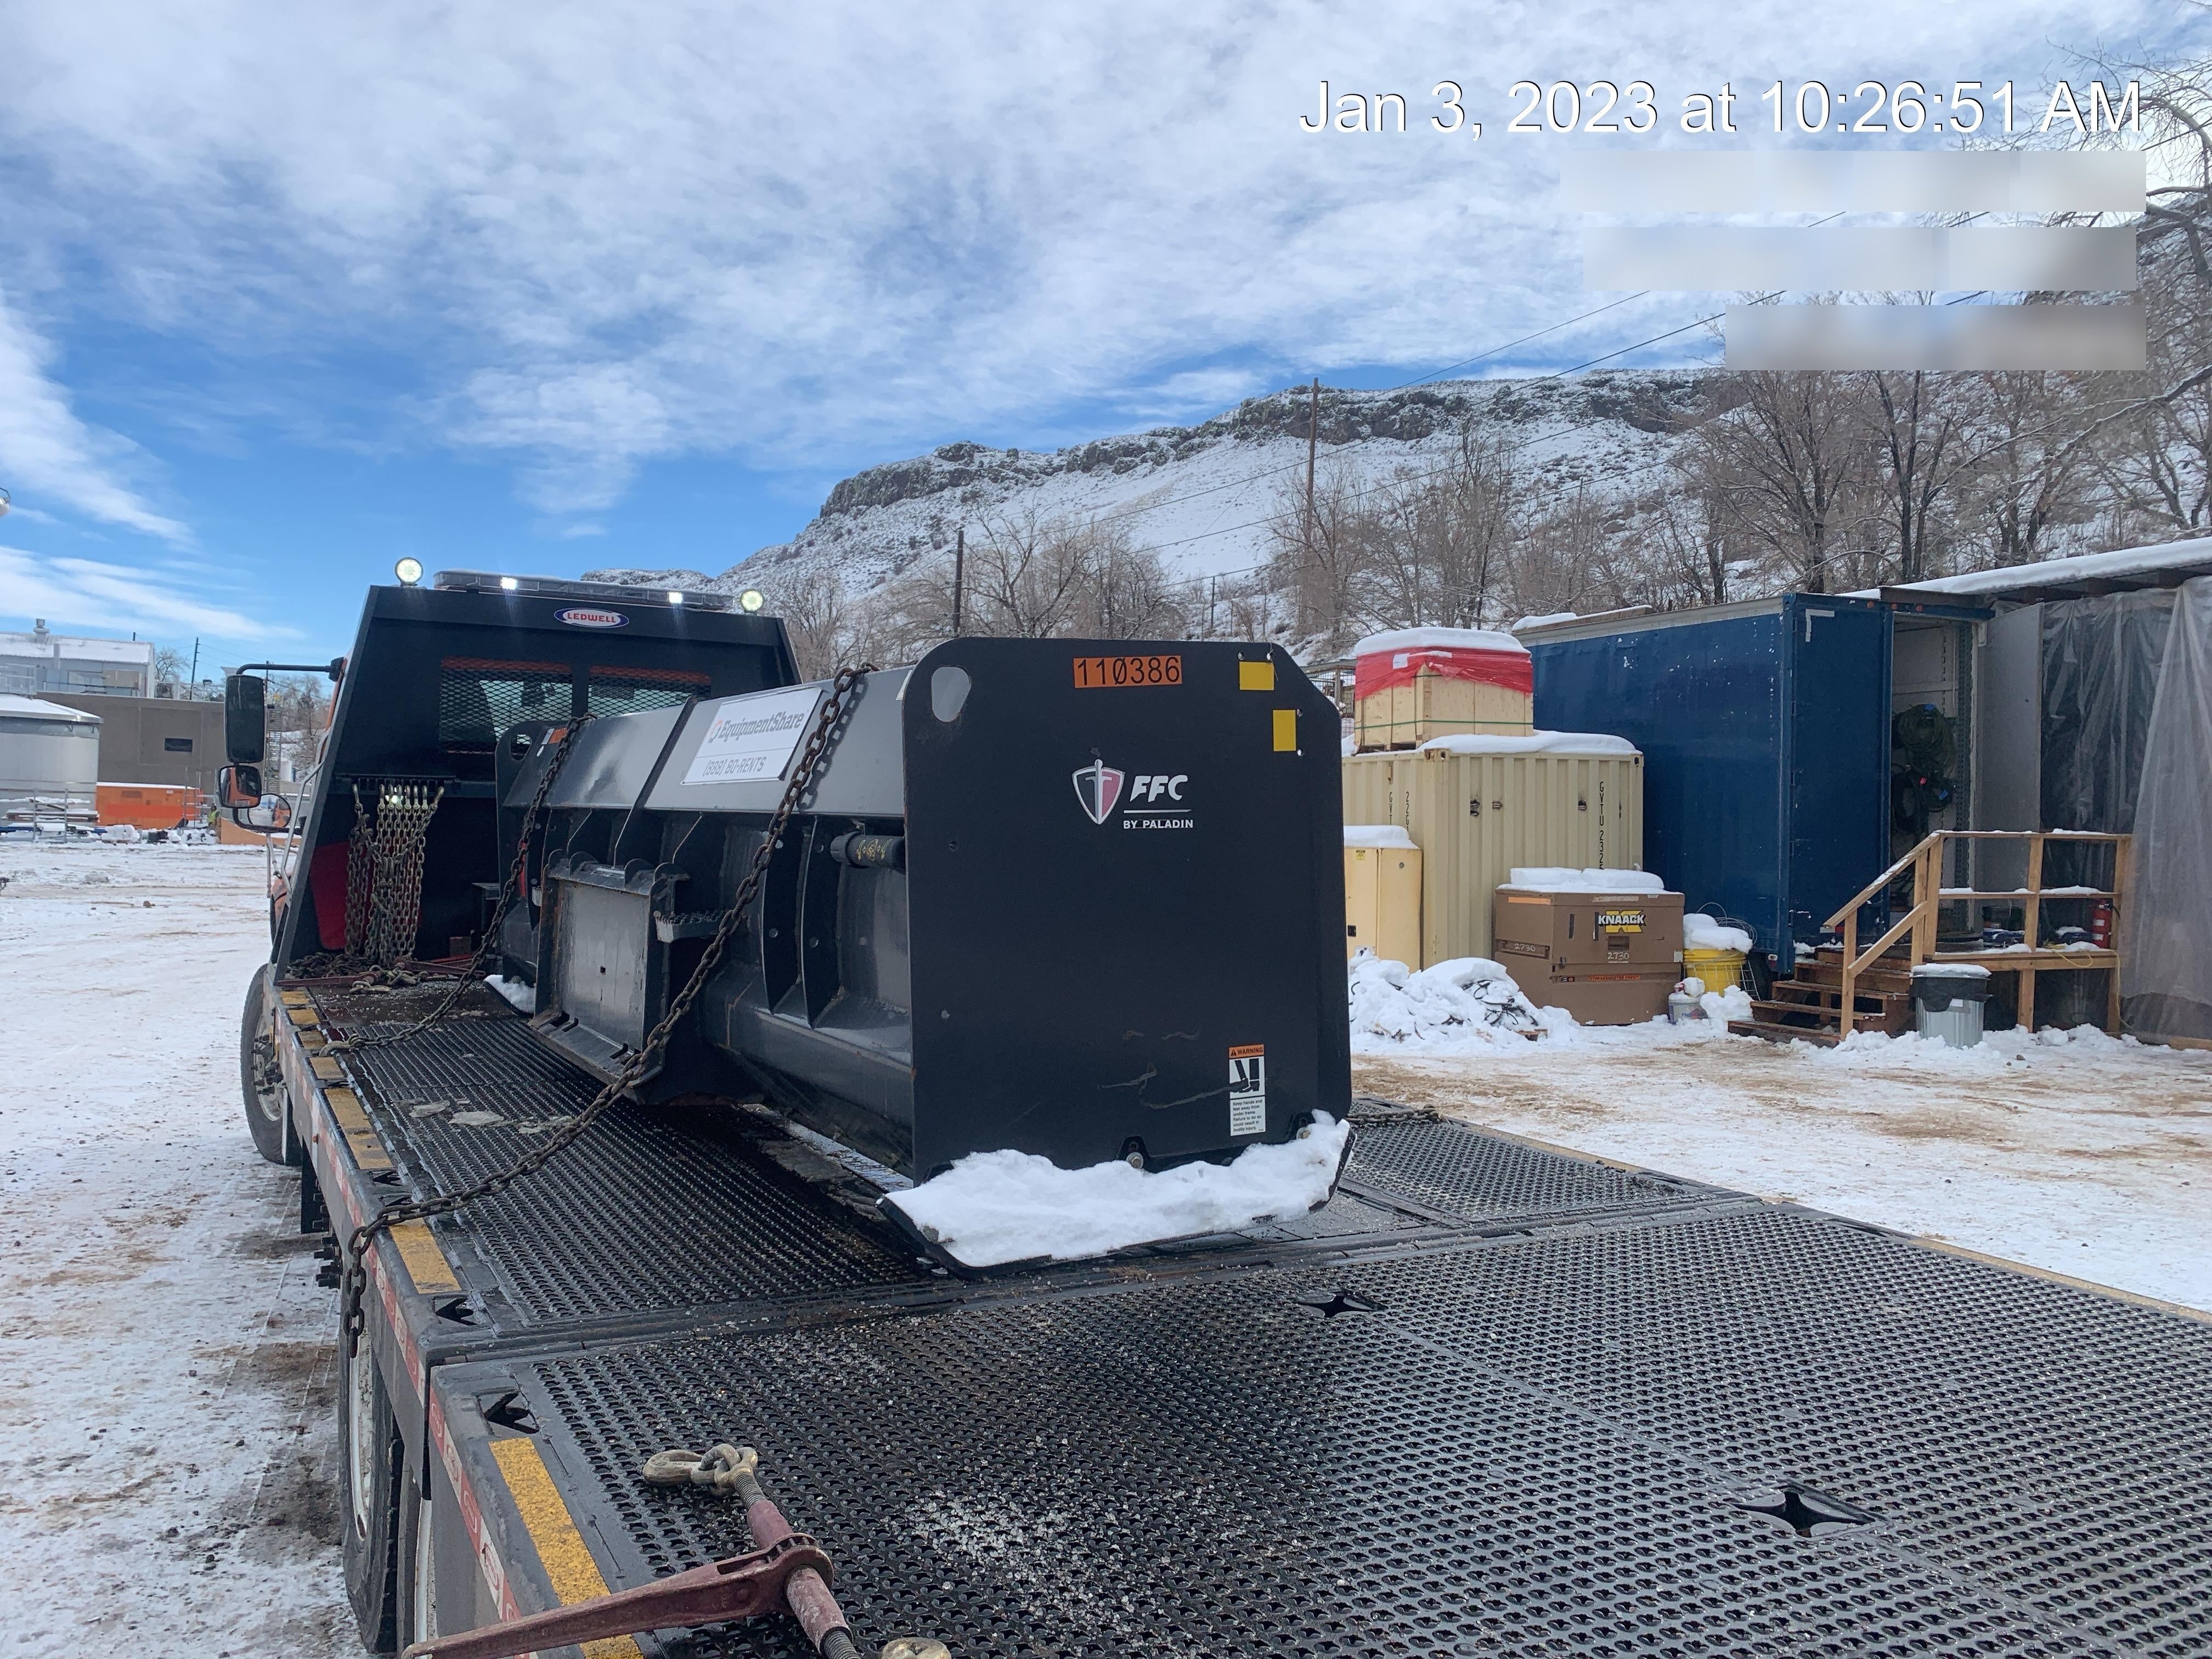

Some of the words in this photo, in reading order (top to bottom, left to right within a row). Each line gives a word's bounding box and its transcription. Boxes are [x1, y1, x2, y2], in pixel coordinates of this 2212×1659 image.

[567, 612, 616, 623] LEDWELL
[1077, 656, 1180, 685] 110386
[718, 712, 805, 742] EquipmentShare
[1130, 775, 1188, 802] FFC
[1123, 820, 1138, 829] BY
[1142, 819, 1194, 828] PALADIN
[1598, 915, 1645, 925] KNAACK
[1514, 943, 1536, 952] 2730
[1607, 952, 1629, 960] 2730
